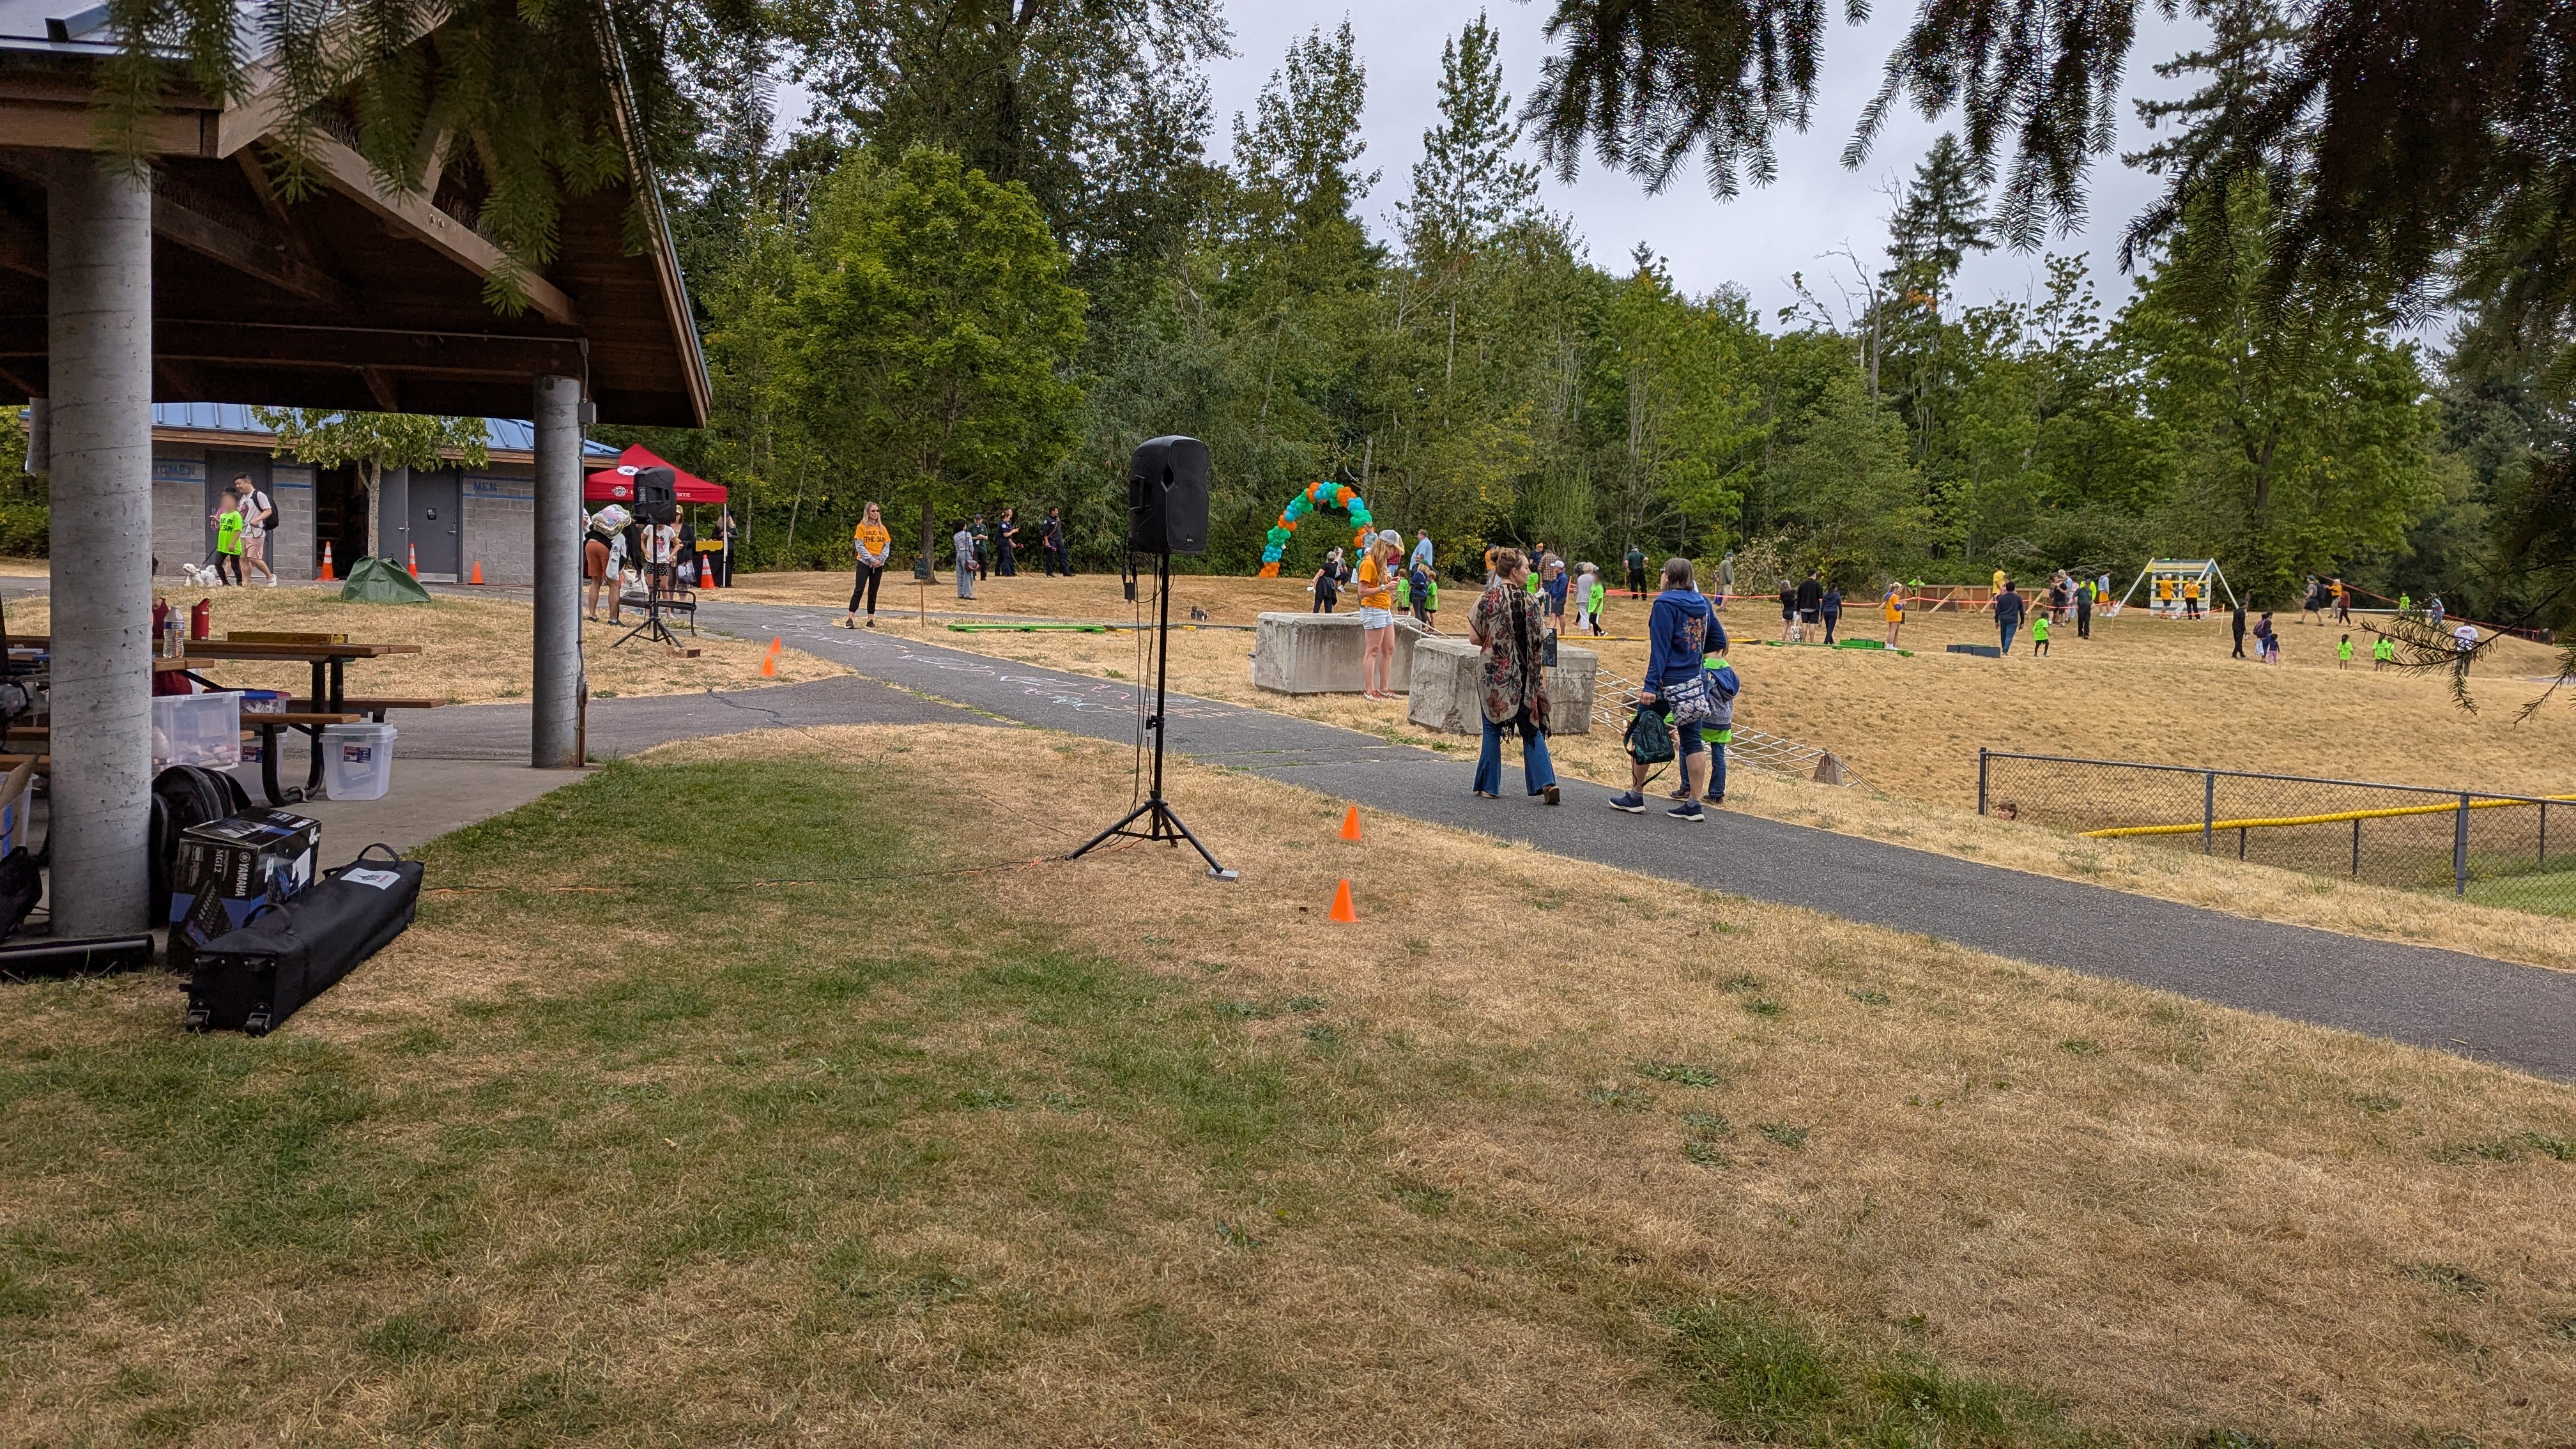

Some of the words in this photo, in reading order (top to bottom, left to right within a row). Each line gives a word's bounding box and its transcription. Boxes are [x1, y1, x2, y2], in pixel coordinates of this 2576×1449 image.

[473, 482, 496, 491] MEN
[214, 848, 224, 873] MG12
[235, 862, 249, 896] YAMAHA
